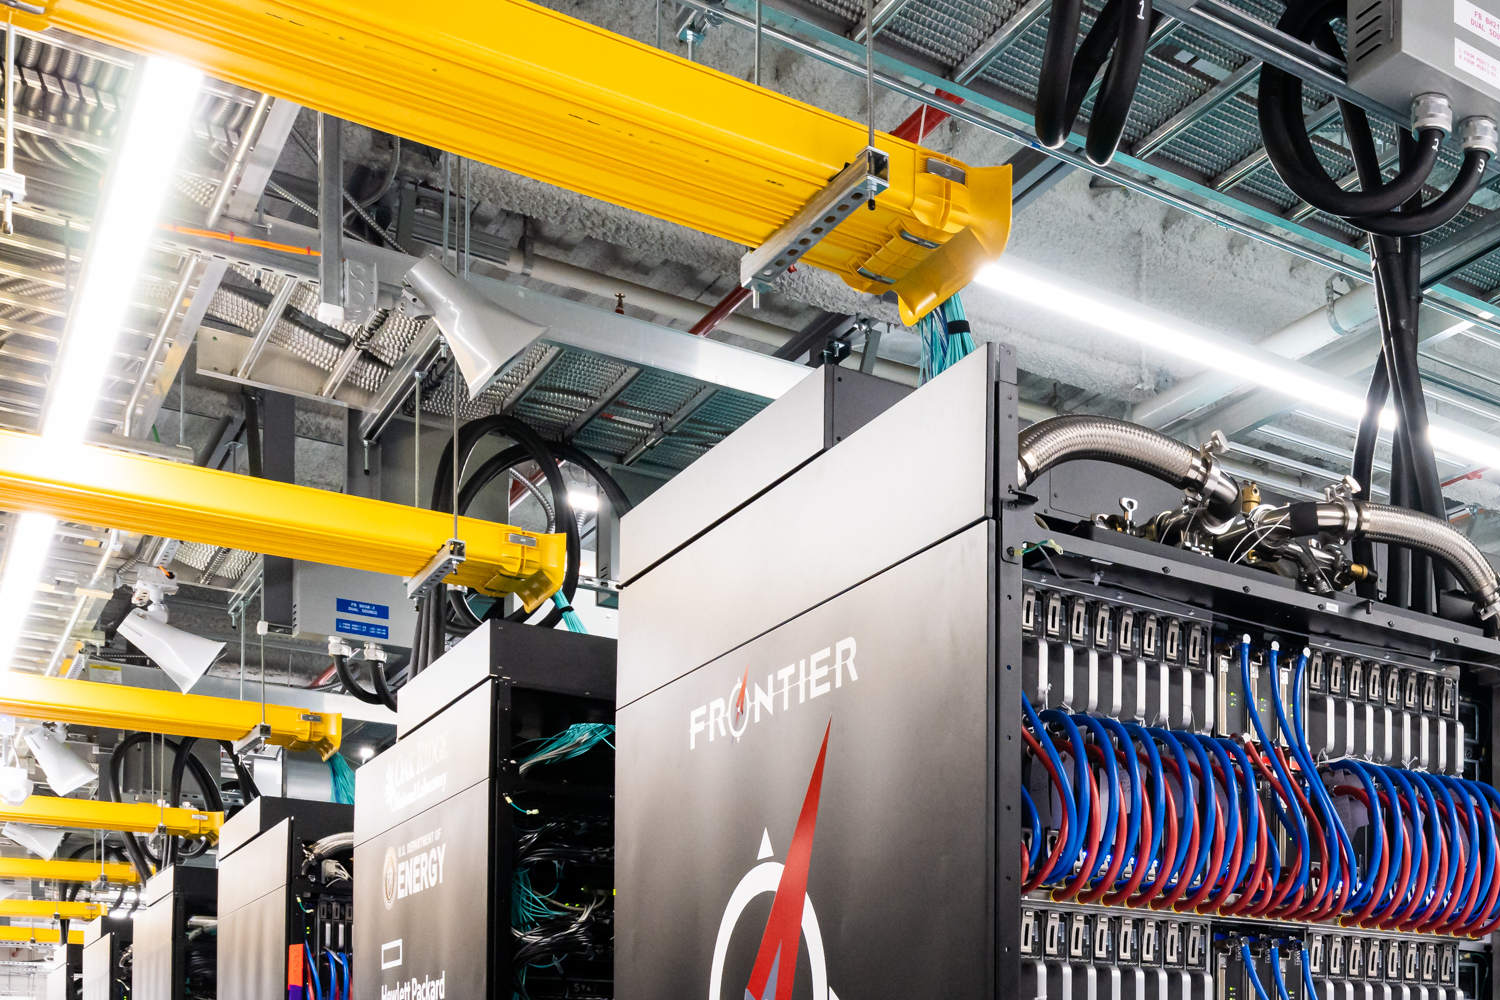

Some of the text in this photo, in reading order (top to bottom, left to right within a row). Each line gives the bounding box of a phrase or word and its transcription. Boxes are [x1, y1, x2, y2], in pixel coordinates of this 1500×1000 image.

[1470, 18, 1486, 32] DUAL
[1464, 50, 1474, 59] FROM
[1464, 56, 1474, 66] FROM
[1432, 138, 1439, 151] 2
[1478, 159, 1485, 173] 3
[689, 636, 859, 750] FRONTIER
[416, 730, 448, 775] RIDGE
[416, 771, 448, 800] Laboratory
[407, 831, 434, 854] DEPARTMENT
[434, 827, 442, 841] OF
[397, 842, 446, 900] ENERGY
